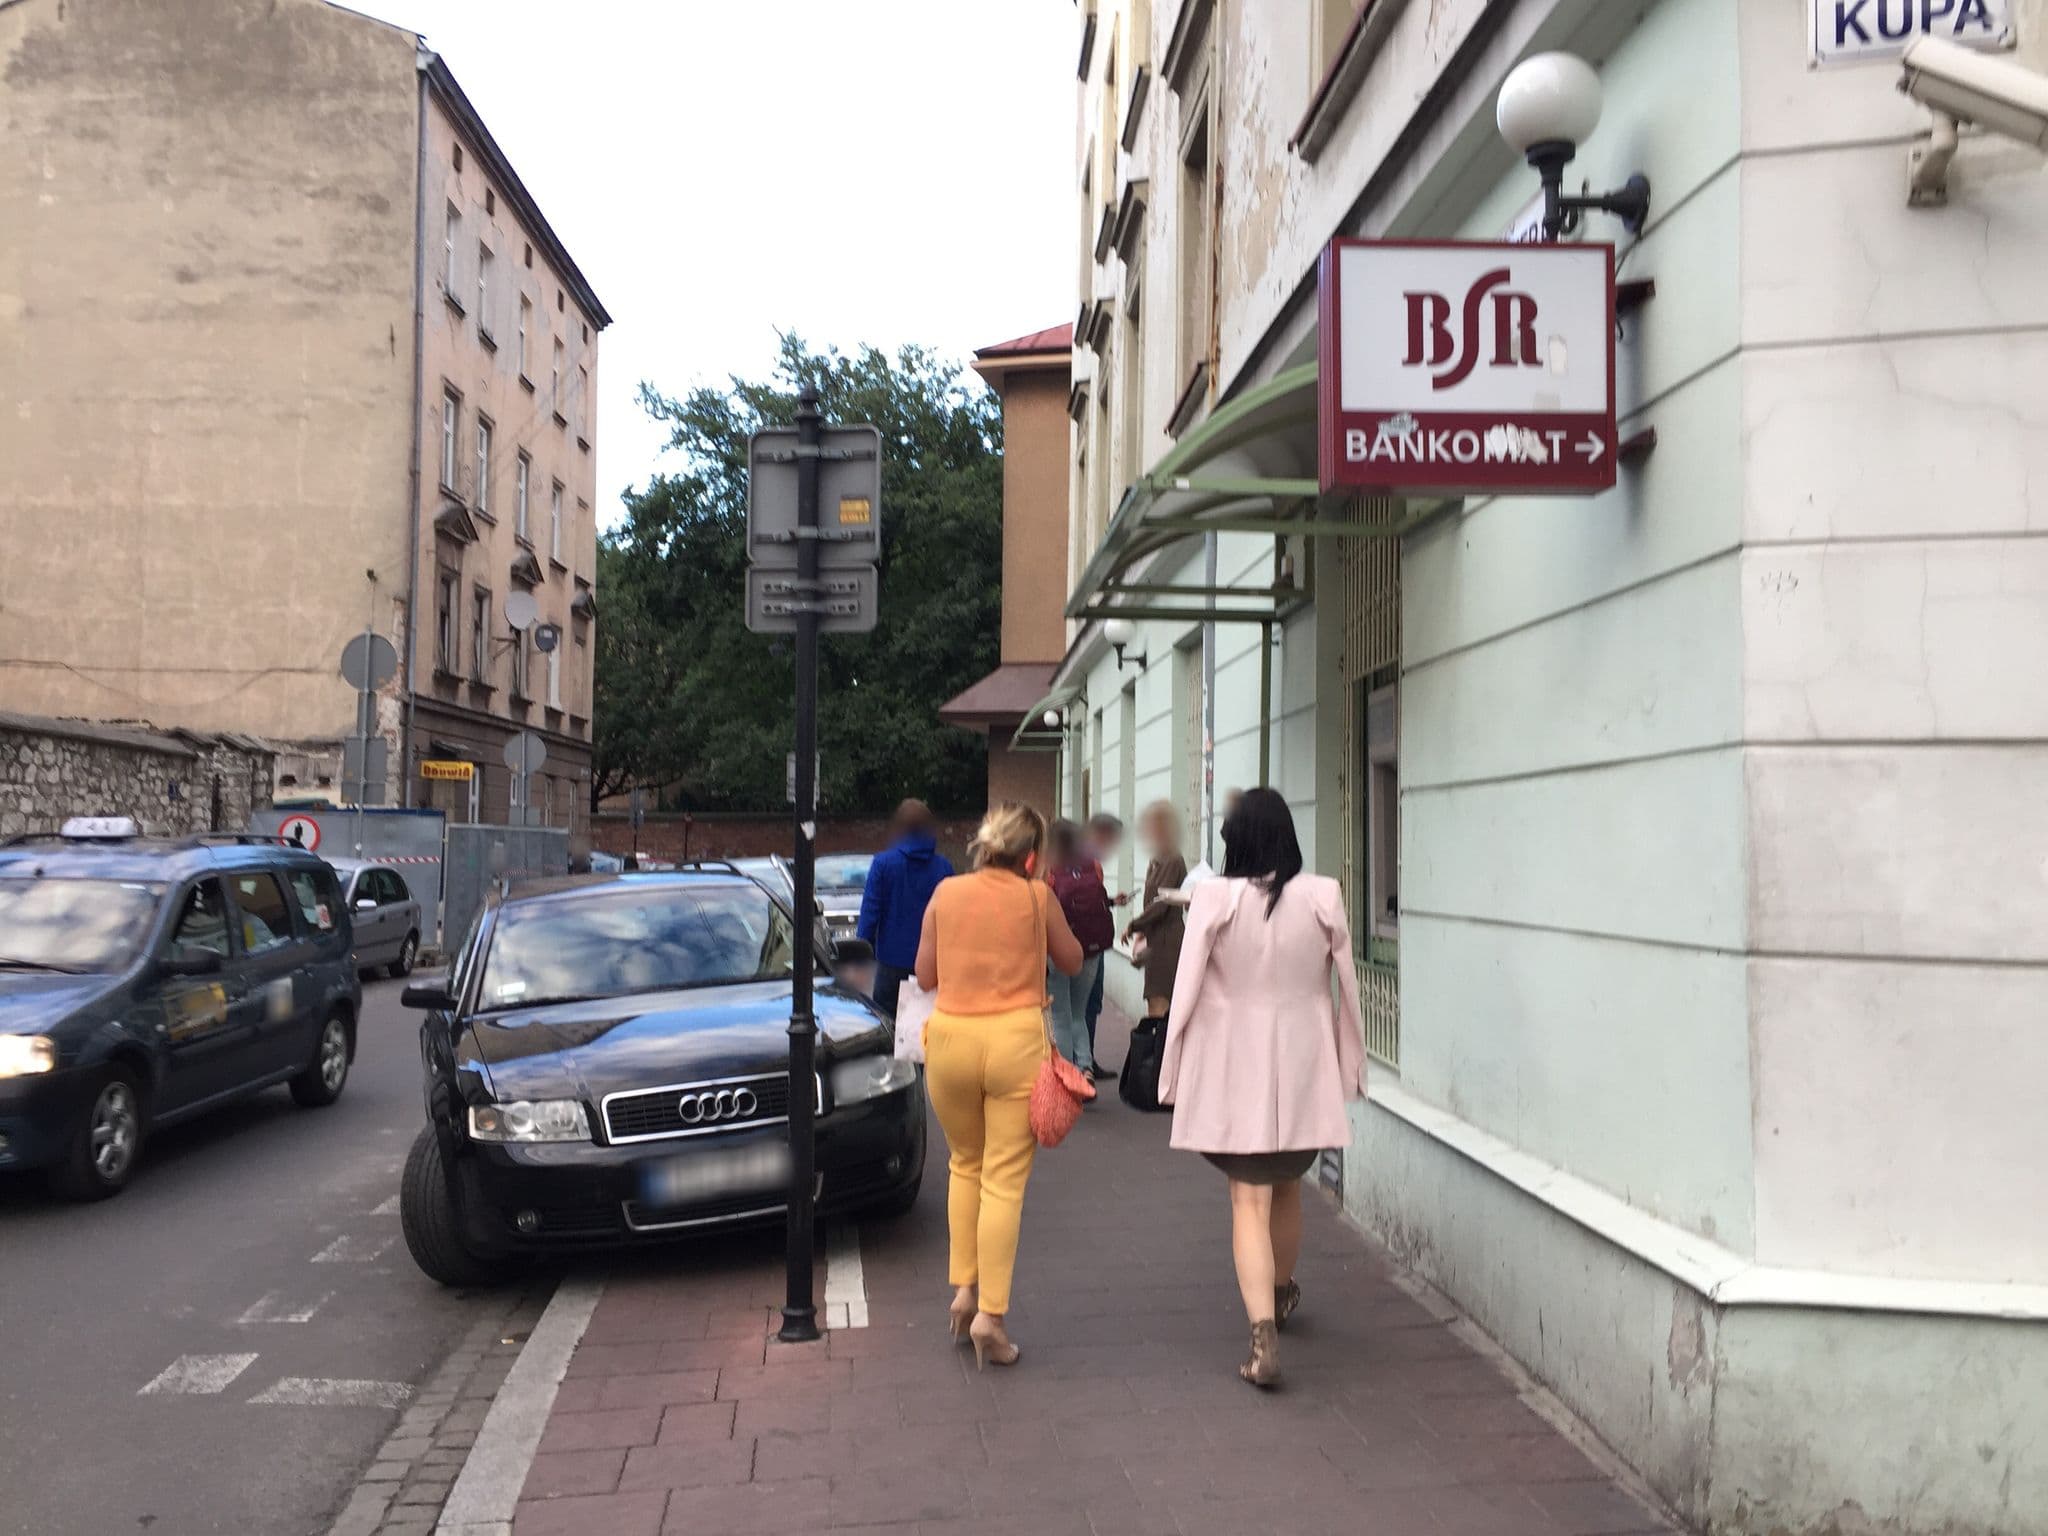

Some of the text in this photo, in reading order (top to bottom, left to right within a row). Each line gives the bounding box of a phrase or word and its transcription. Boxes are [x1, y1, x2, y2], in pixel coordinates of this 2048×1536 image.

[1835, 0, 1993, 47] KUPA
[1402, 266, 1543, 391] BSR
[1346, 429, 1567, 465] BANKOT
